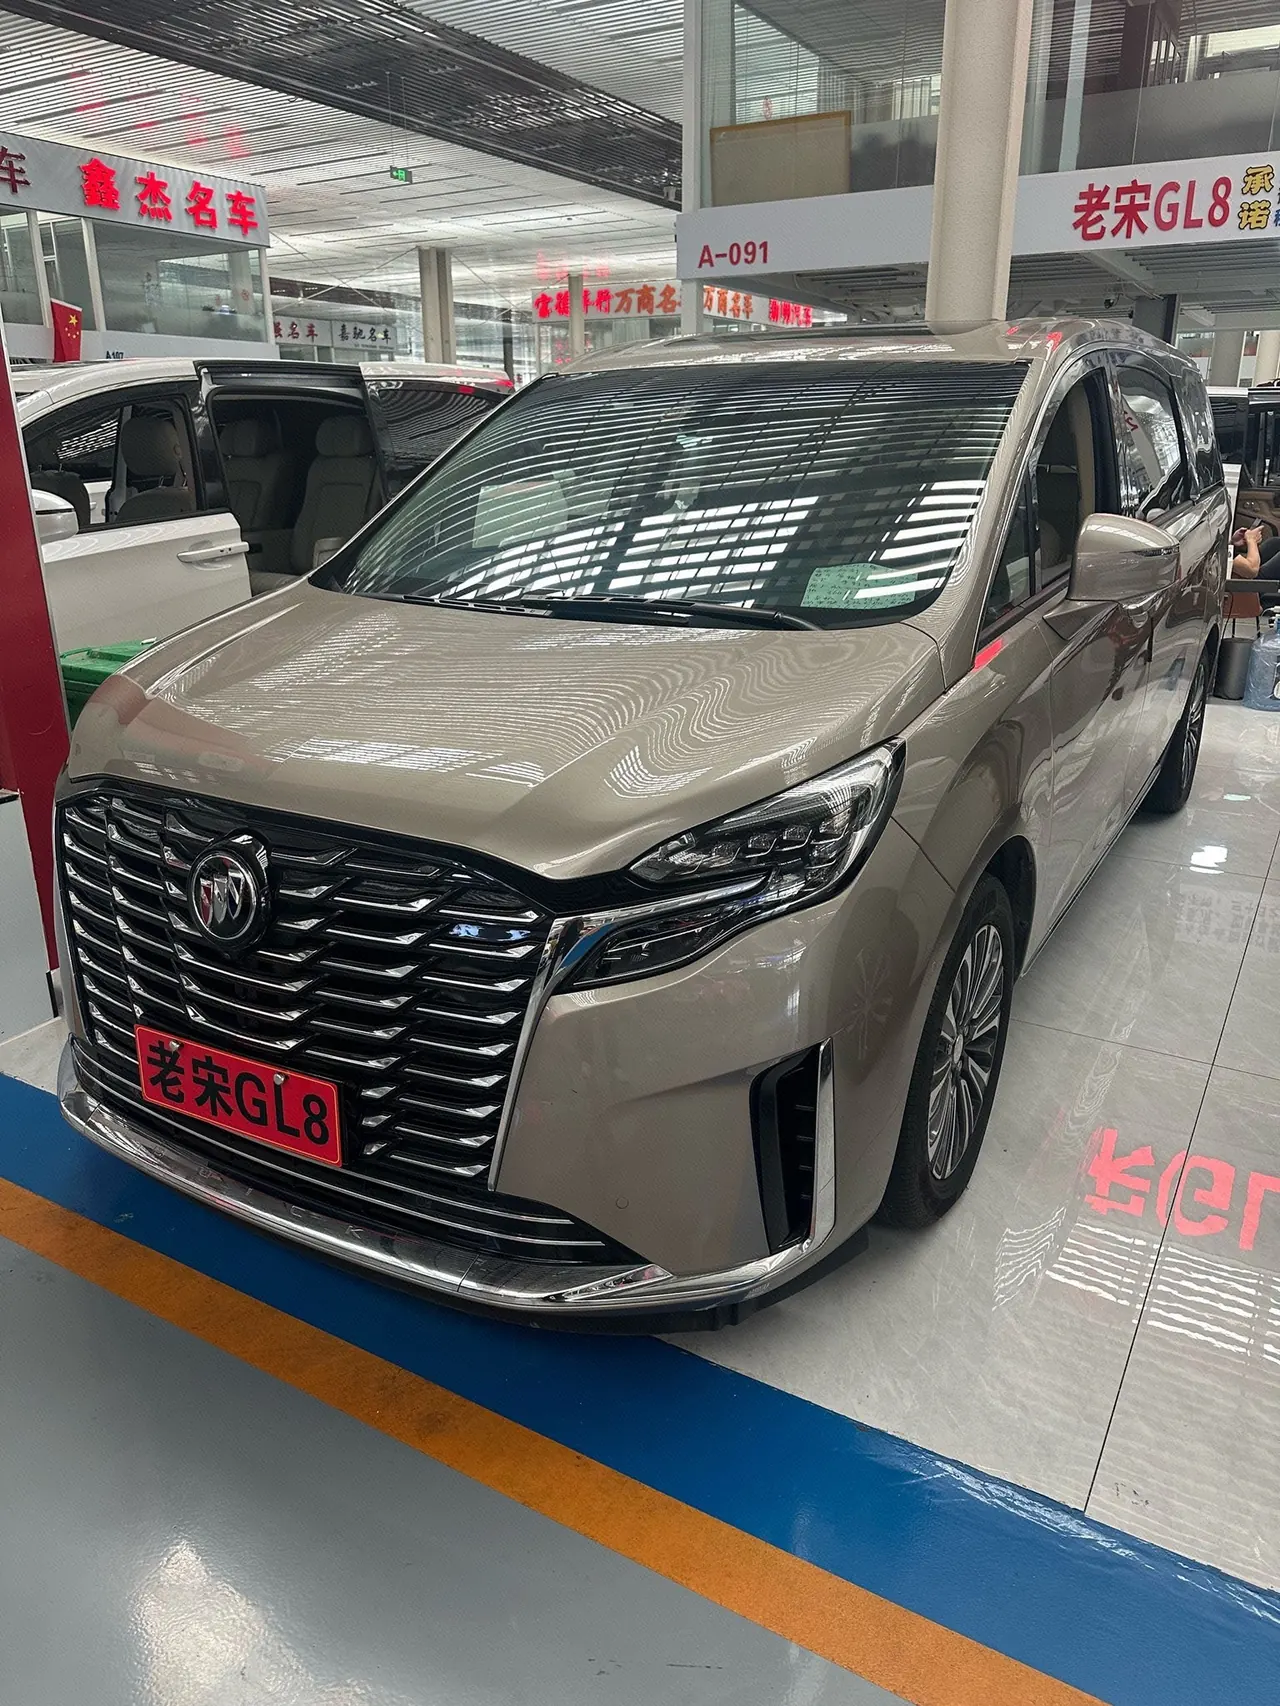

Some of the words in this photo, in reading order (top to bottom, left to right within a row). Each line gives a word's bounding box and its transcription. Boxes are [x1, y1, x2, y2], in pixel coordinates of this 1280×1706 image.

[80, 157, 259, 236] 鑫杰名车
[1072, 176, 1232, 241] 老宋GL8
[1238, 164, 1275, 230] 承诺
[697, 241, 768, 269] A-091
[615, 284, 682, 314] 万商名
[147, 1040, 330, 1146] 老宋GL8
